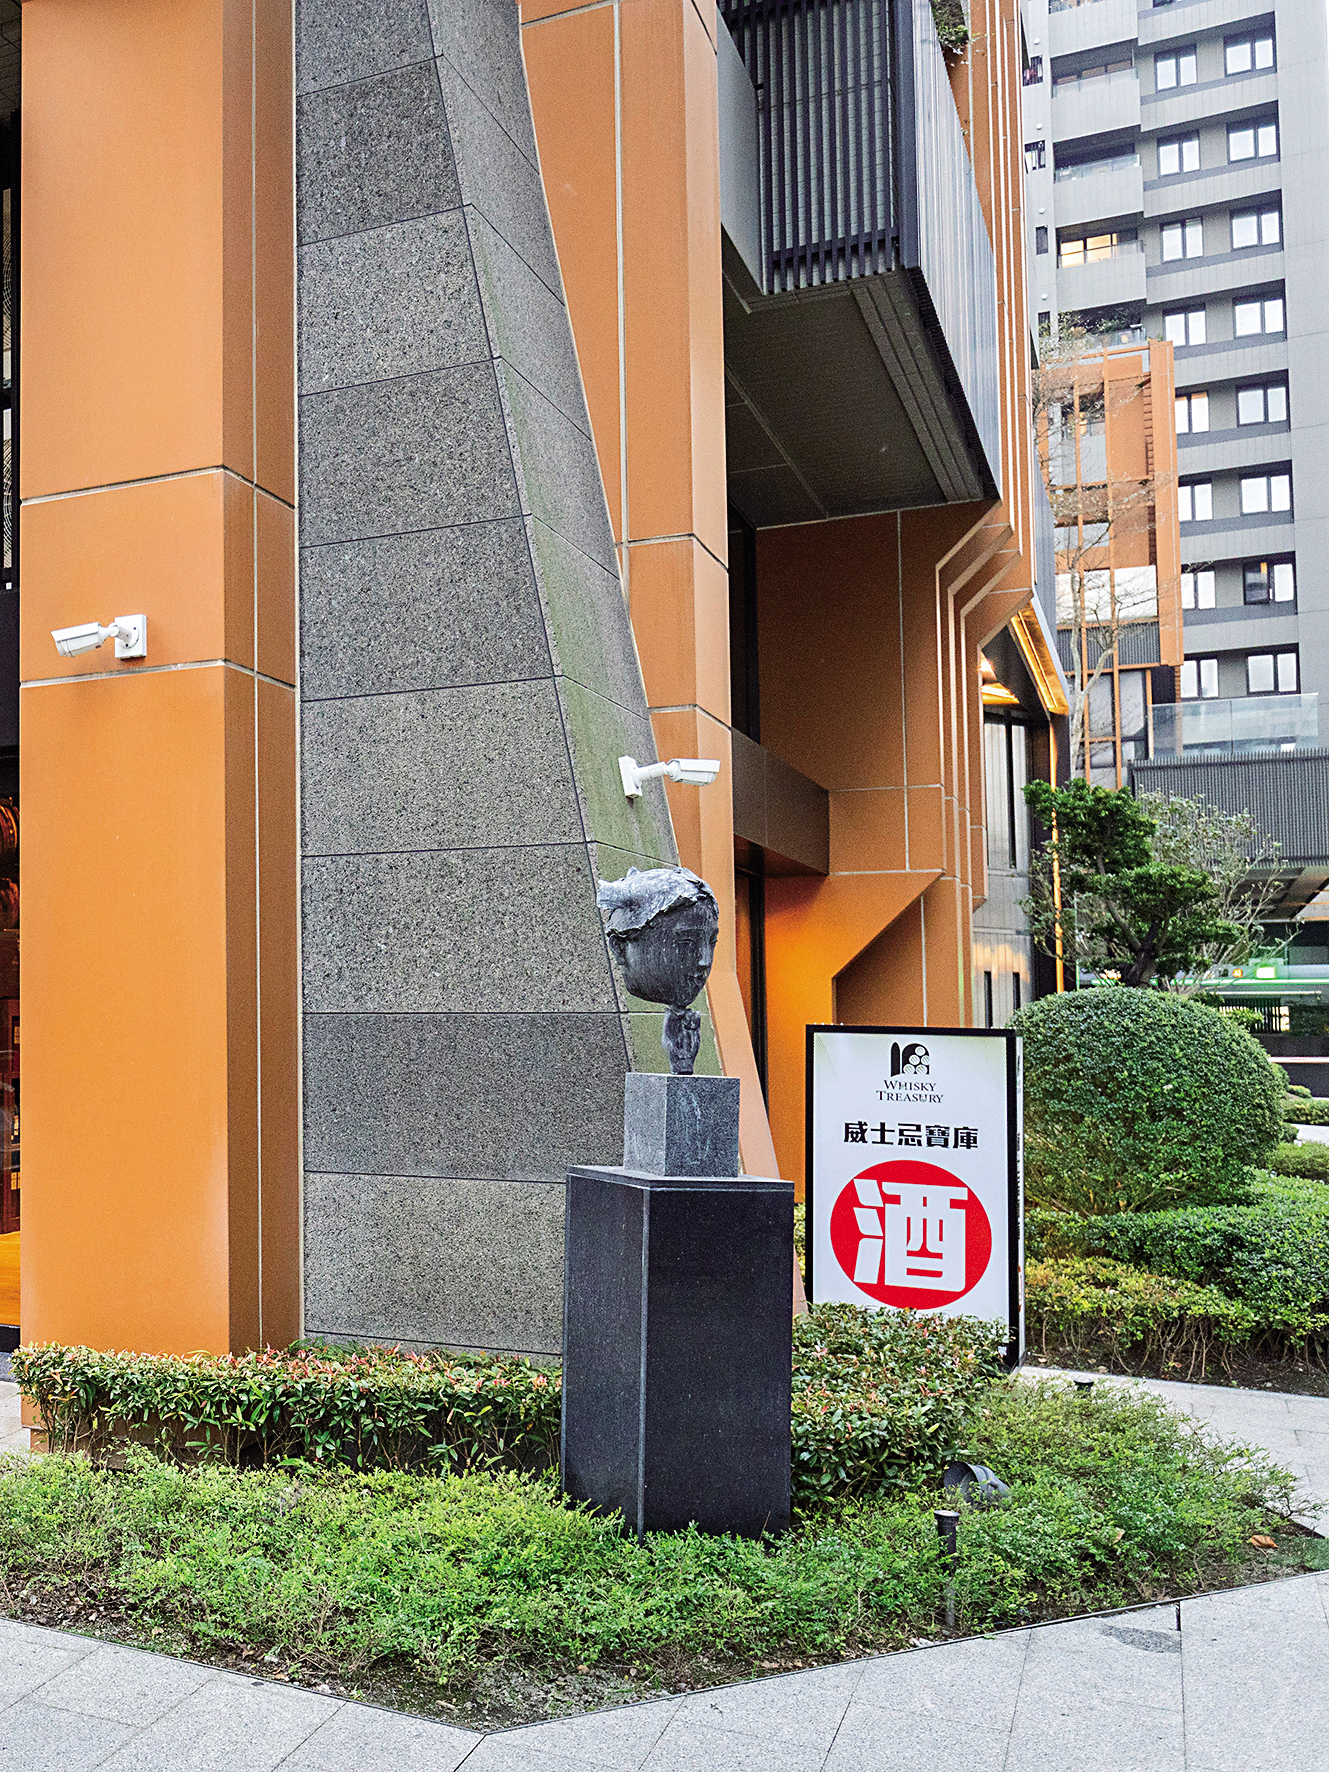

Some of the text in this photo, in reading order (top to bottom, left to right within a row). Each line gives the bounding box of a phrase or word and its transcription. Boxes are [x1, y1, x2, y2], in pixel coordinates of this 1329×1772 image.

[883, 1079, 937, 1092] WHISKY
[876, 1090, 944, 1104] TREASURY
[843, 1120, 979, 1150] 威士忌寶庫
[853, 1178, 969, 1293] 酒
